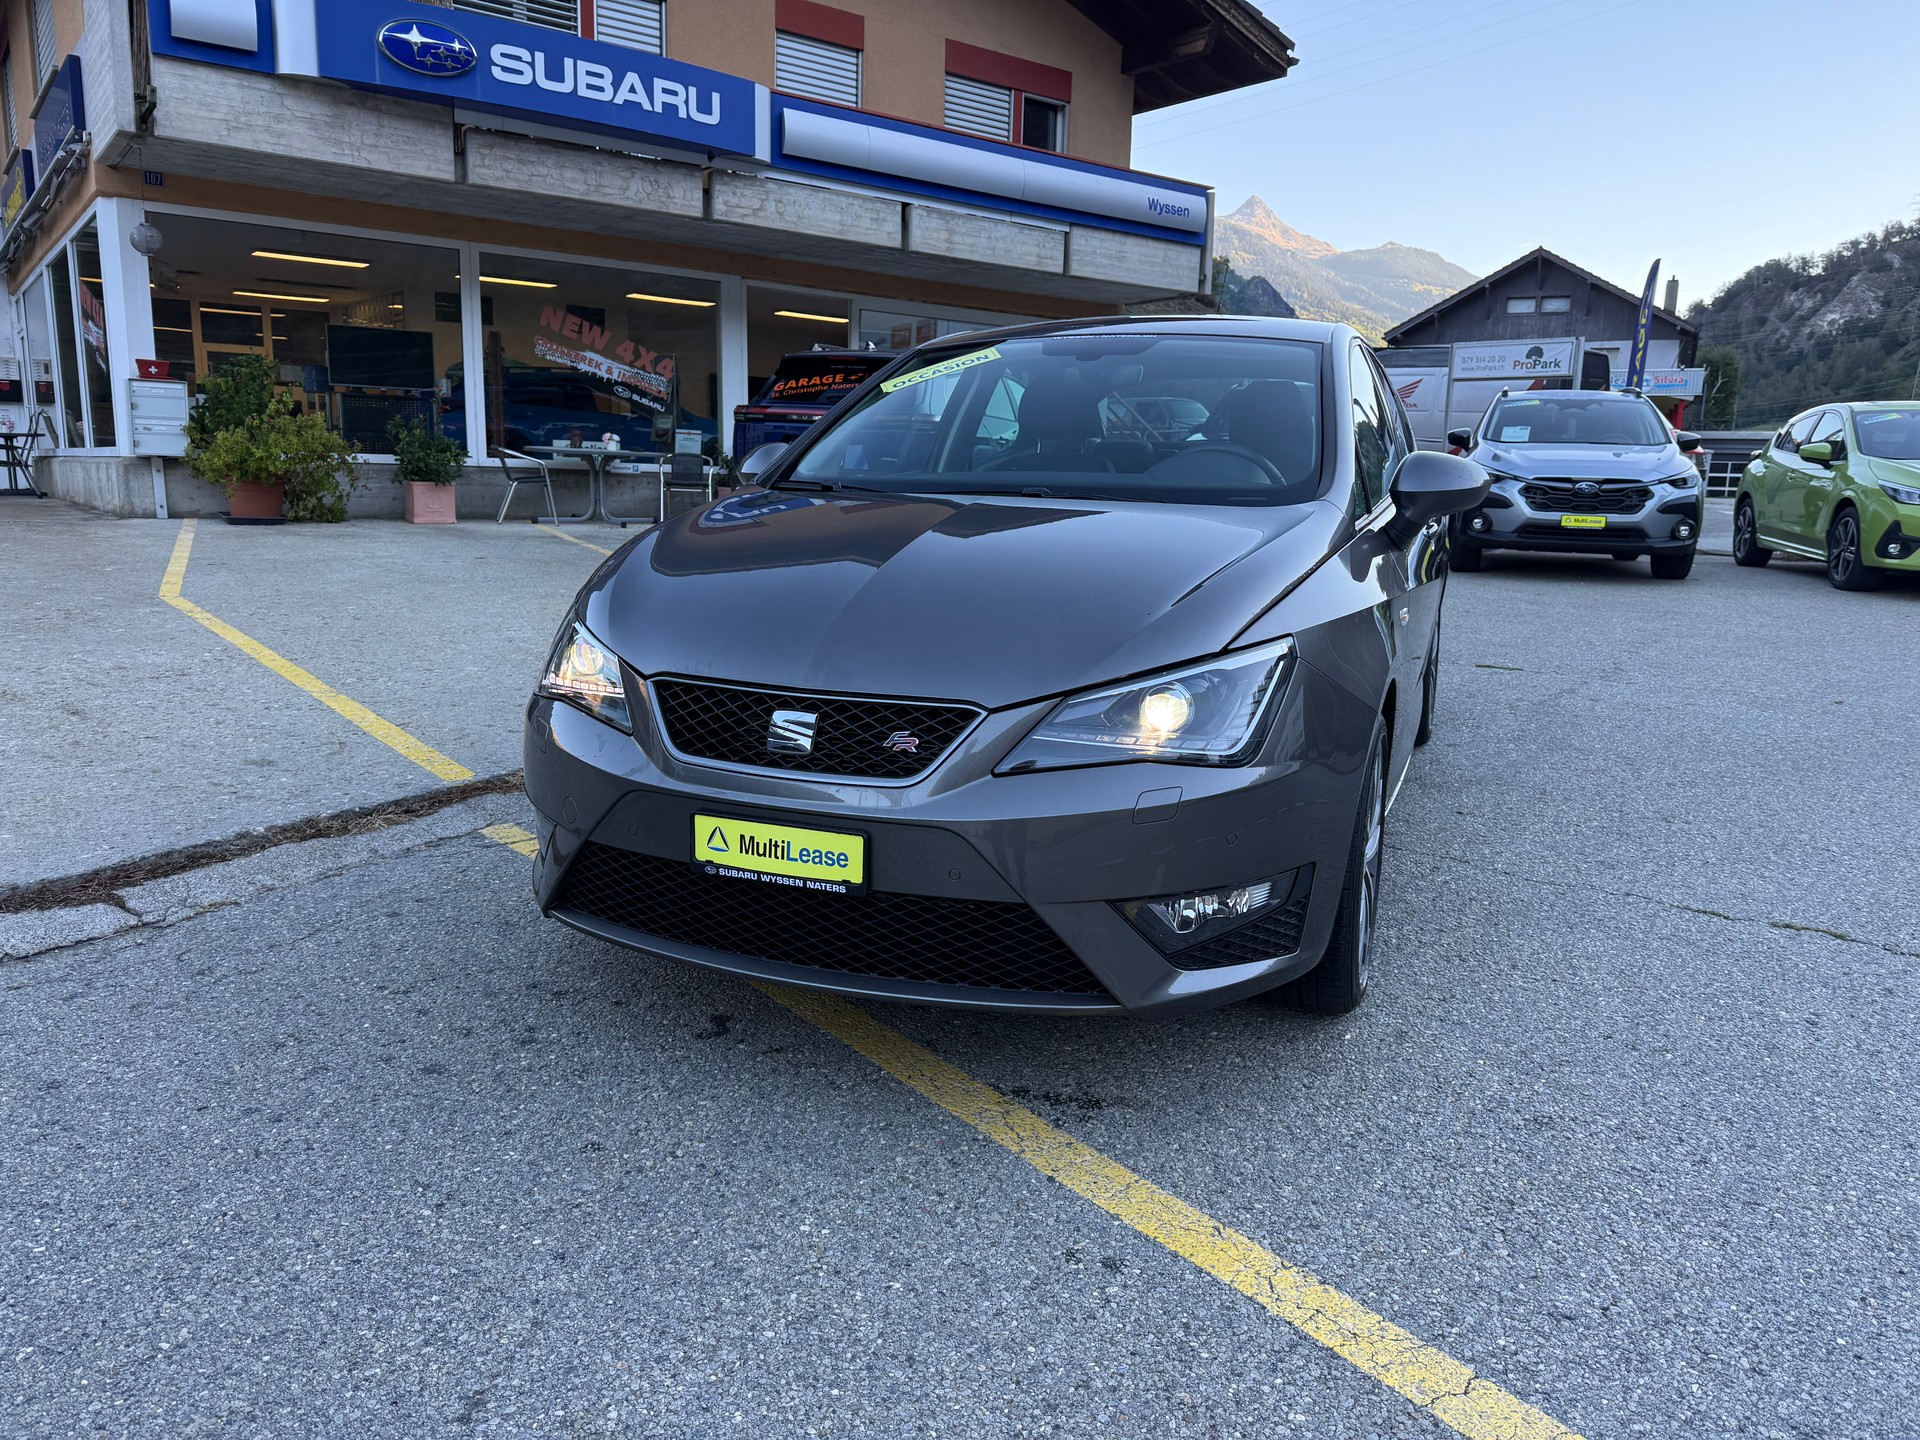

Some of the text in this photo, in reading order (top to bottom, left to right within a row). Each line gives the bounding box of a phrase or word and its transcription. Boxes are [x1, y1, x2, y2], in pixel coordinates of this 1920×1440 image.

[490, 43, 721, 126] SUBARU
[145, 171, 162, 185] 107
[1147, 196, 1190, 218] Wyssen
[540, 303, 674, 382] NEW 4X4
[605, 365, 615, 378] &
[892, 354, 990, 388] OCCASION
[1513, 358, 1562, 370] ProPark
[773, 373, 845, 392] GARAGE
[783, 384, 829, 396] Christophe
[831, 382, 860, 390] Naters
[631, 393, 666, 413] SUBARU
[739, 833, 849, 869] MultiLease
[718, 867, 847, 893] SUBARU WYSSEN NATERS
